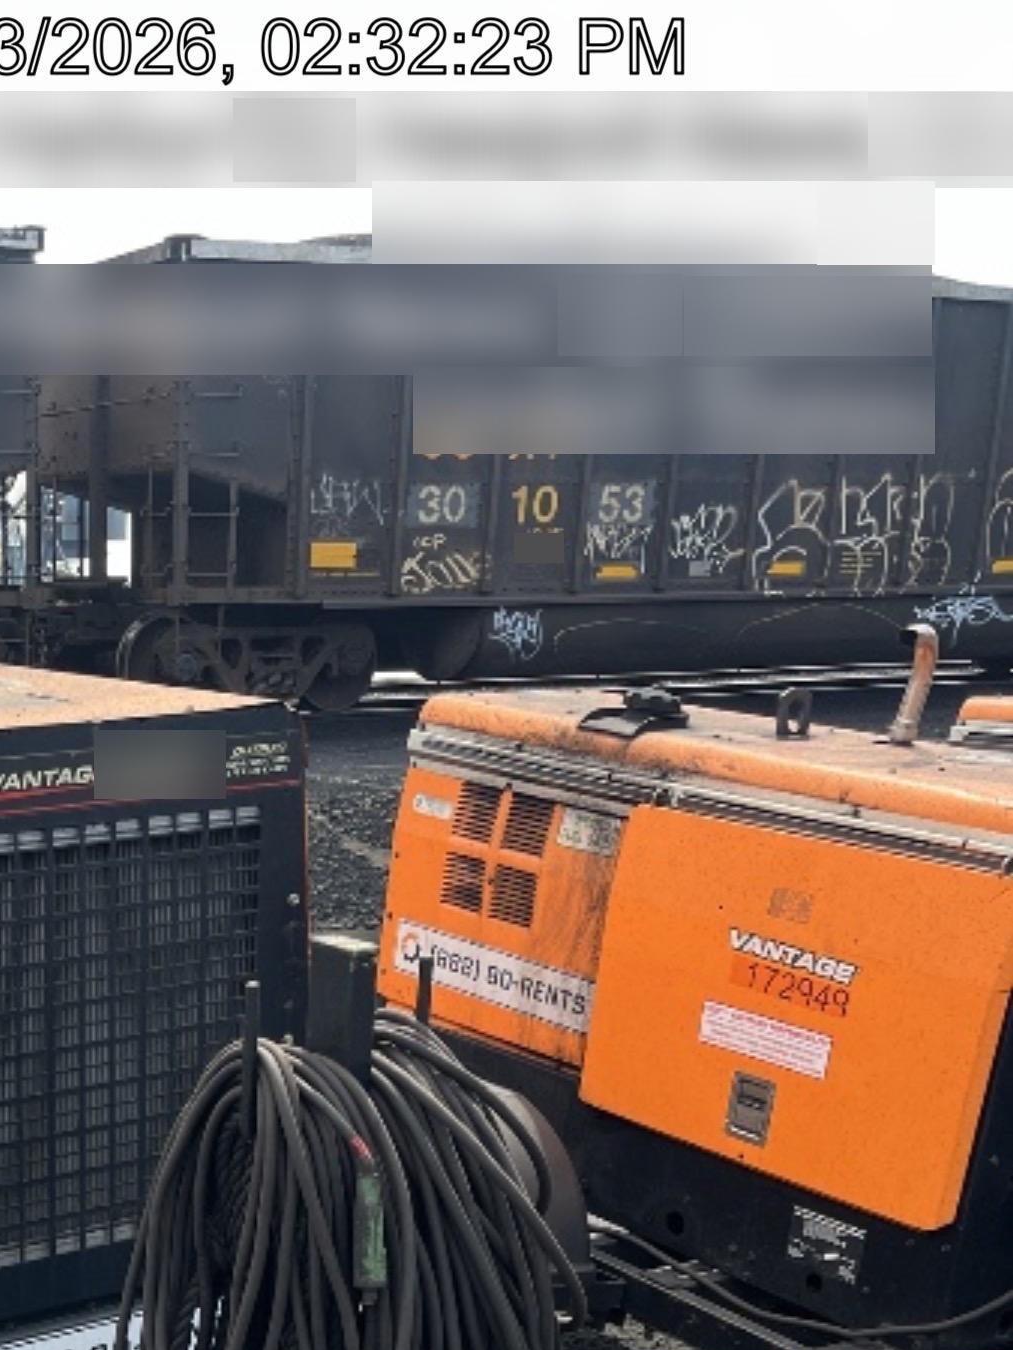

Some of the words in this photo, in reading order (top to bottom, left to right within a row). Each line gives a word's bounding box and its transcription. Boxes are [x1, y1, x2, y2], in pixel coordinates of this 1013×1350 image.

[418, 485, 466, 523] 30
[511, 485, 558, 525] 10
[598, 485, 645, 522] 53
[729, 927, 859, 985] VANTAGE
[748, 962, 850, 1017] 172949
